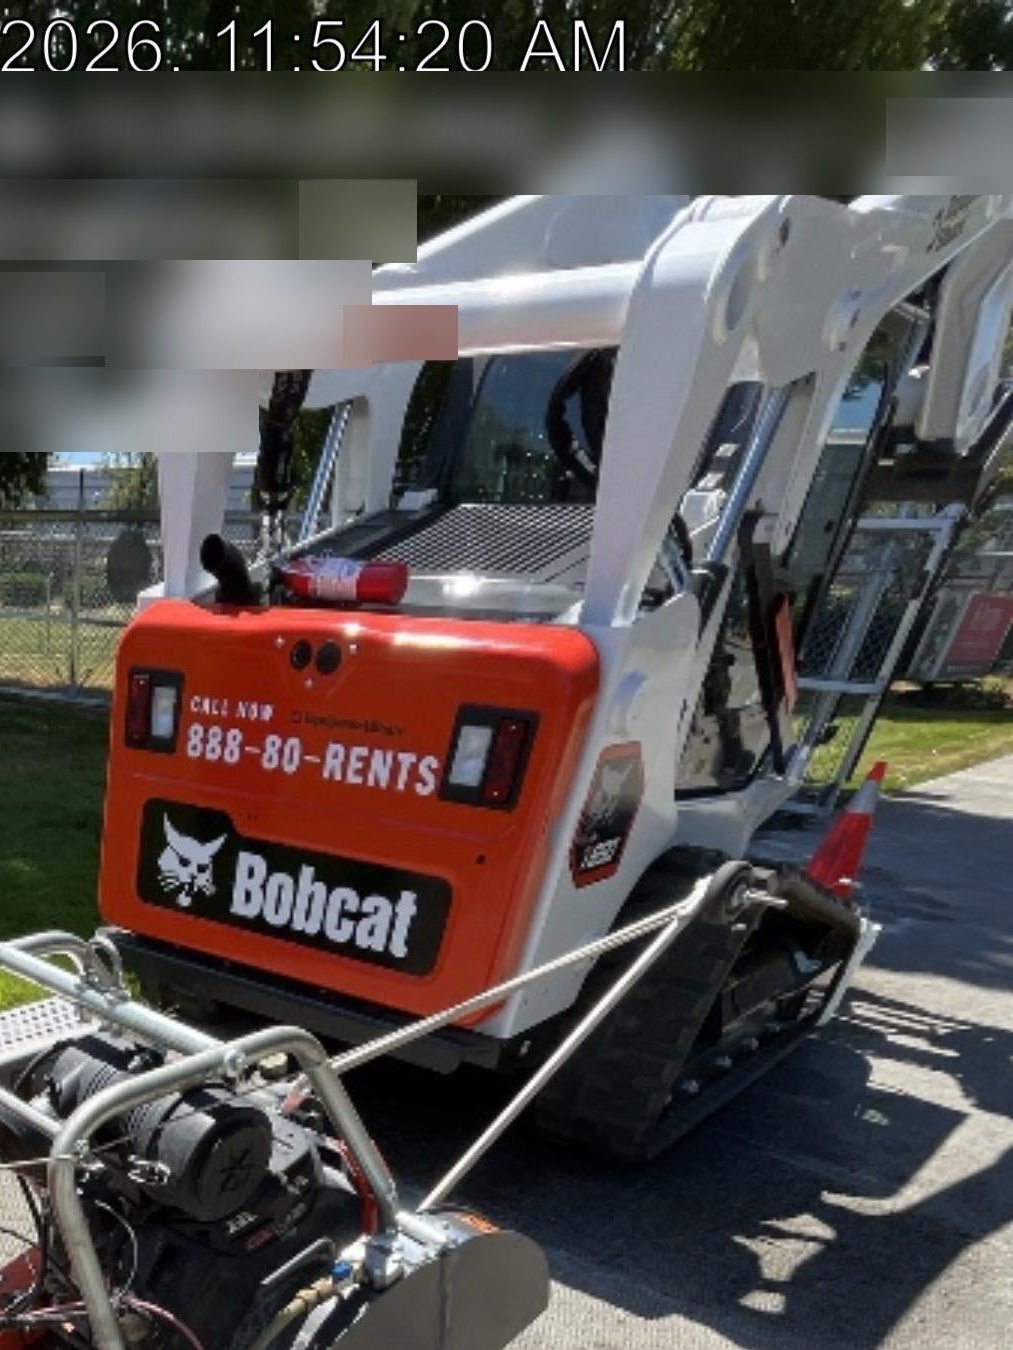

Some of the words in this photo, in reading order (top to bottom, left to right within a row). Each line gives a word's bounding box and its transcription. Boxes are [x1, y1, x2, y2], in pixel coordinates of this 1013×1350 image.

[190, 695, 229, 718] CALL
[236, 700, 274, 722] NOW
[187, 722, 438, 796] 888-80-RENTS
[229, 850, 418, 959] Bobcat
